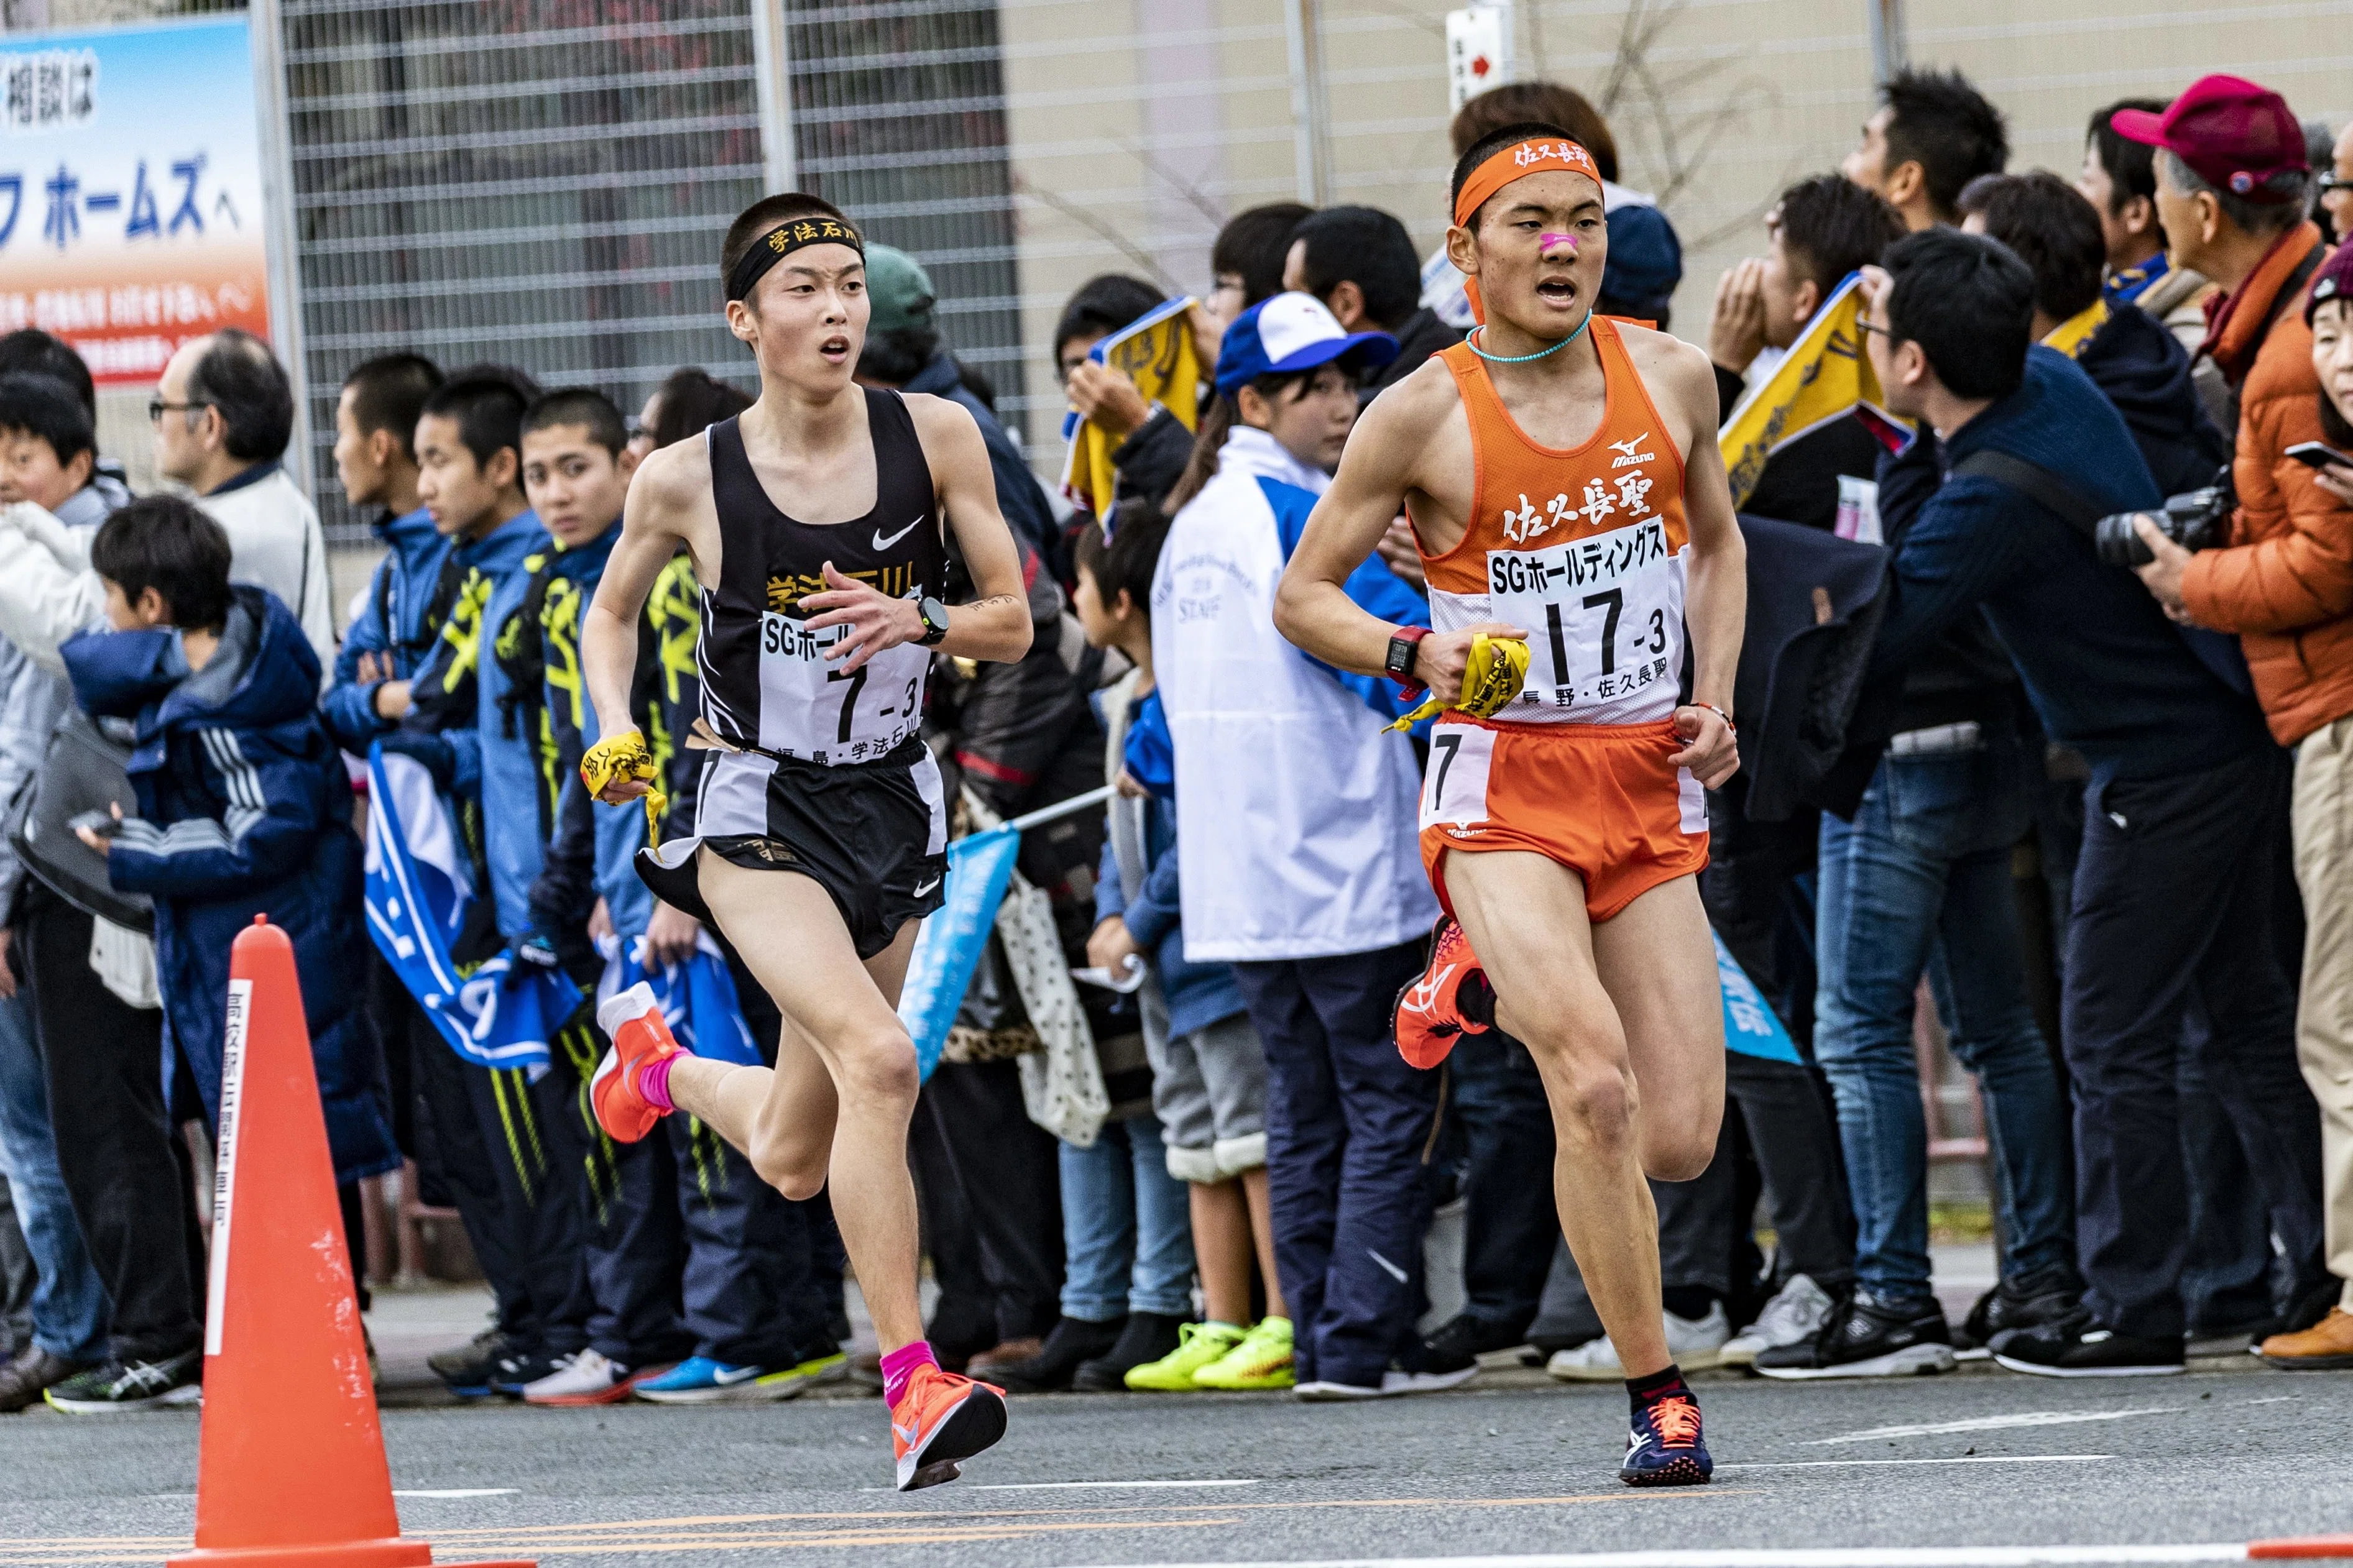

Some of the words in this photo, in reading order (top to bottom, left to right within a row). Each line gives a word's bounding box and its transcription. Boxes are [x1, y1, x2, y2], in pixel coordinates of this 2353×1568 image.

[1514, 143, 1591, 171] 佐久長聖
[768, 222, 860, 253] 学法石川
[1503, 469, 1654, 545] 佐久長聖
[1492, 524, 1665, 595] SGホールディングス
[1425, 734, 1463, 816] 7
